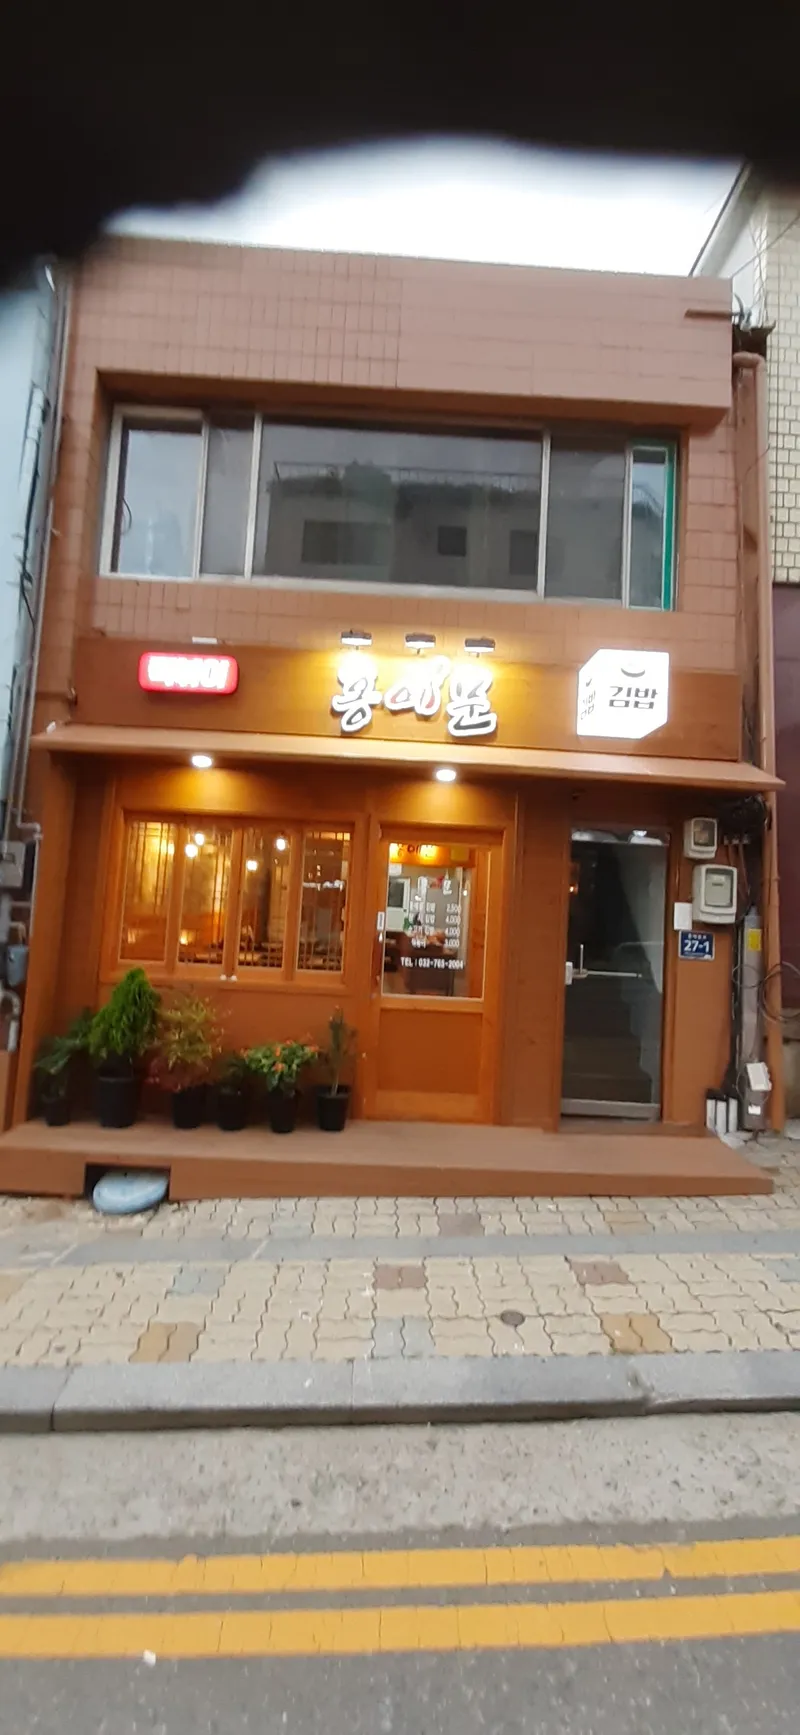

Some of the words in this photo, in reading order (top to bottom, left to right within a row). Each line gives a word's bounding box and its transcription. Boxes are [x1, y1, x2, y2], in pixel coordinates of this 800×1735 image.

[609, 685, 658, 709] 김밥
[684, 939, 710, 953] 27-1
[400, 956, 414, 968] TEL
